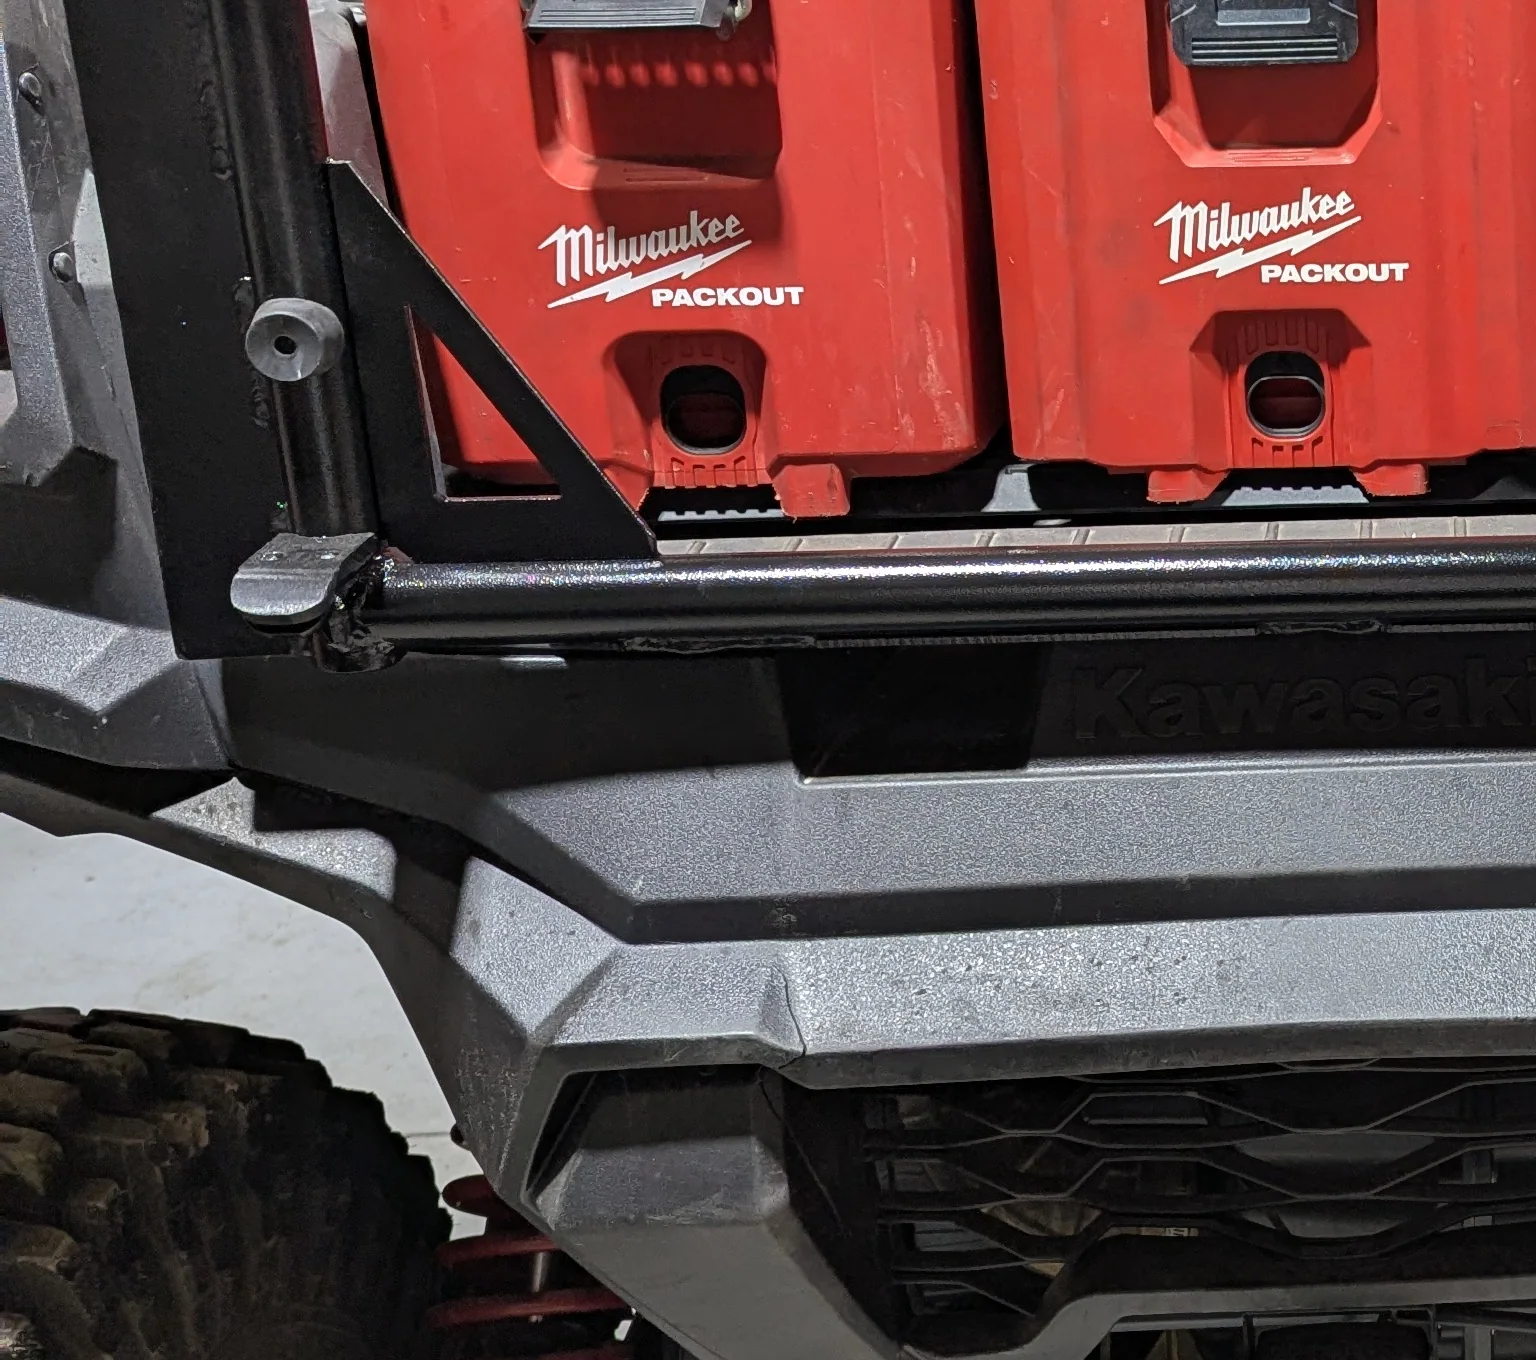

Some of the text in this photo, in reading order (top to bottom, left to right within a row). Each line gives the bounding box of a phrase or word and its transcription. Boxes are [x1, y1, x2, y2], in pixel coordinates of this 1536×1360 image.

[538, 210, 745, 287] Milwaukee
[1154, 187, 1355, 264] Milwaukee
[651, 285, 805, 309] PACKOUT
[1260, 262, 1410, 284] PACKOUT
